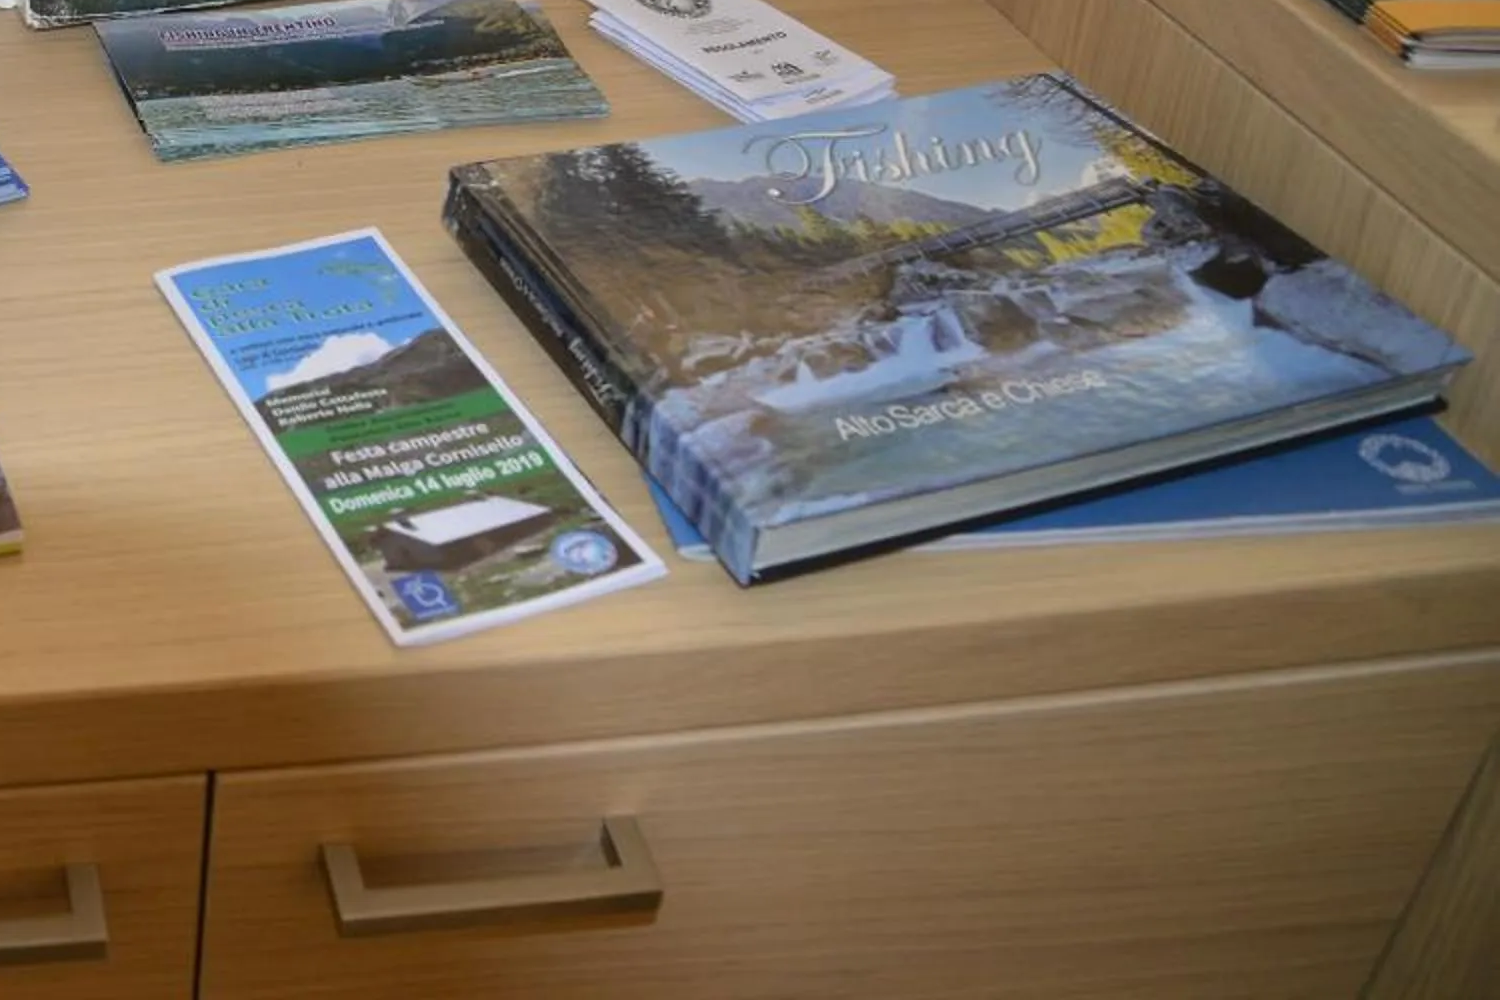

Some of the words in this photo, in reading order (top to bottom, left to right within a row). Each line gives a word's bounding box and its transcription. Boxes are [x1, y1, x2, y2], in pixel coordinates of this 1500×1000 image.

[743, 124, 1042, 204] Fishing
[835, 410, 897, 441] Alto
[898, 392, 982, 429] Sarca
[1005, 369, 1107, 404] Chiese
[324, 470, 362, 490] alla
[362, 458, 425, 482] Malga
[425, 434, 525, 467] Cornisello
[330, 440, 387, 466] Festa
[389, 423, 490, 453] campestre
[329, 484, 416, 515] Domenica
[415, 476, 442, 496] 14
[440, 465, 497, 490] luglio
[495, 451, 545, 477] 2019
